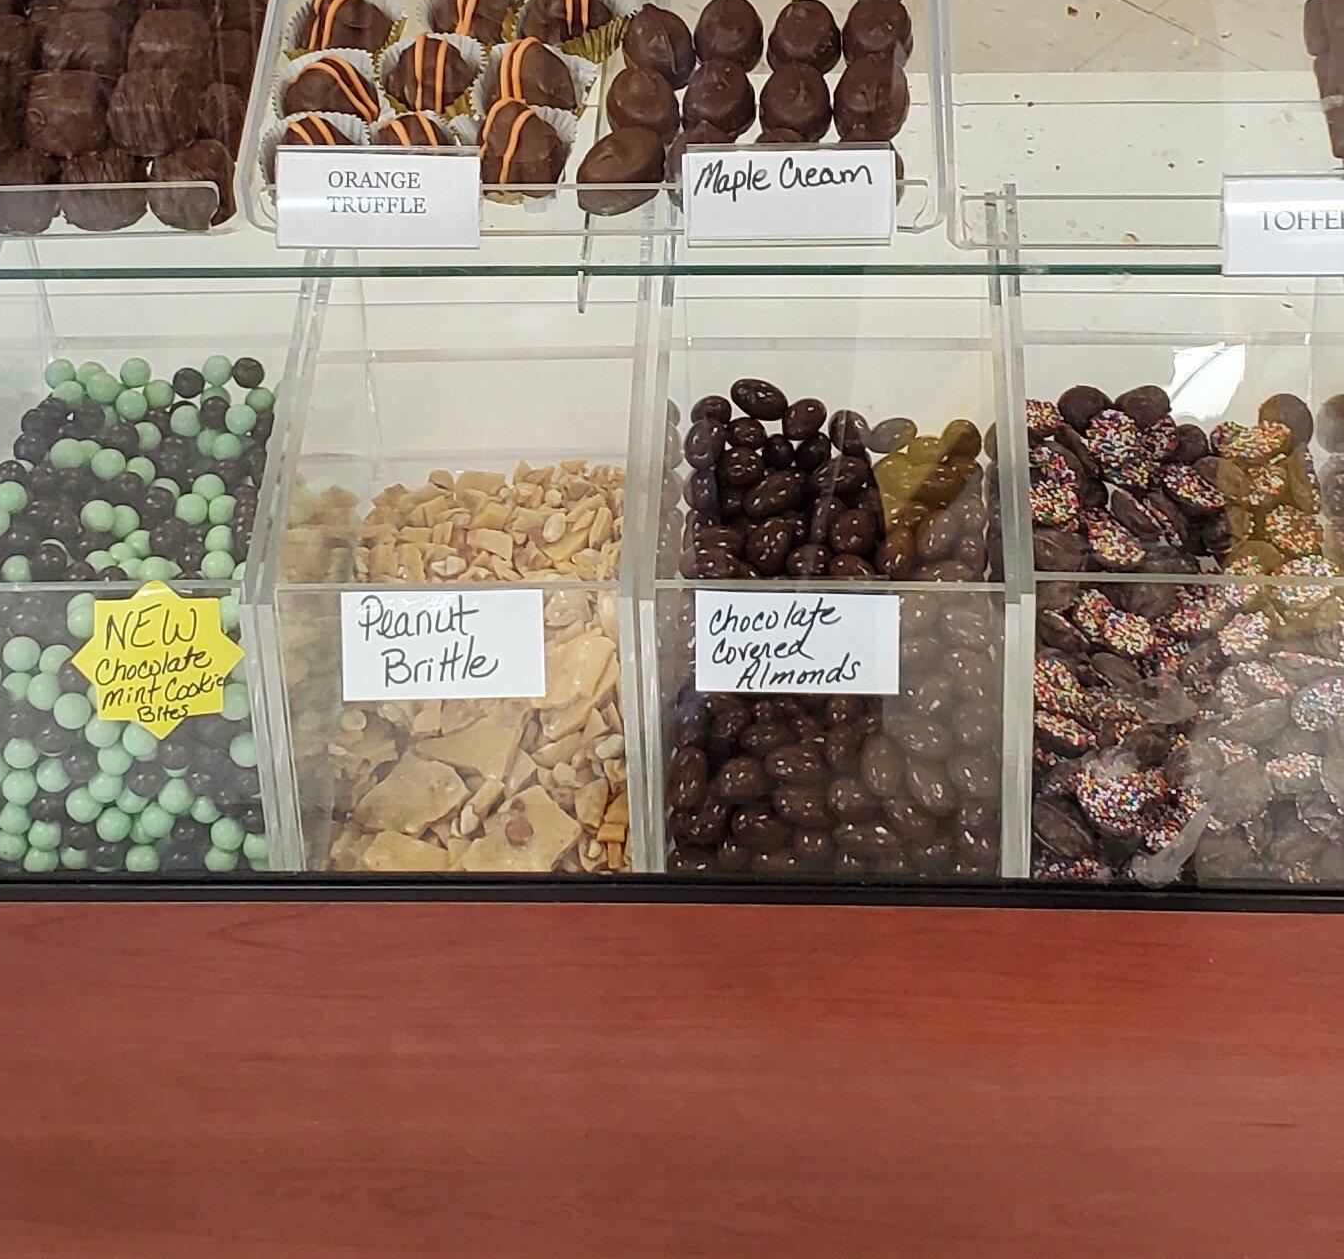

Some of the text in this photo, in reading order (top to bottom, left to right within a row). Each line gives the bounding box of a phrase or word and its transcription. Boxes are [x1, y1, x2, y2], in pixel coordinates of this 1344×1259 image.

[327, 171, 421, 190] ORANGE
[693, 158, 874, 203] Maple Cream
[327, 195, 427, 215] TRUFFLE
[105, 603, 197, 651] NEW
[358, 594, 478, 641] Peanut
[95, 646, 212, 686] Chocolate
[381, 636, 499, 688] Brittle
[736, 652, 862, 690] Almonds
